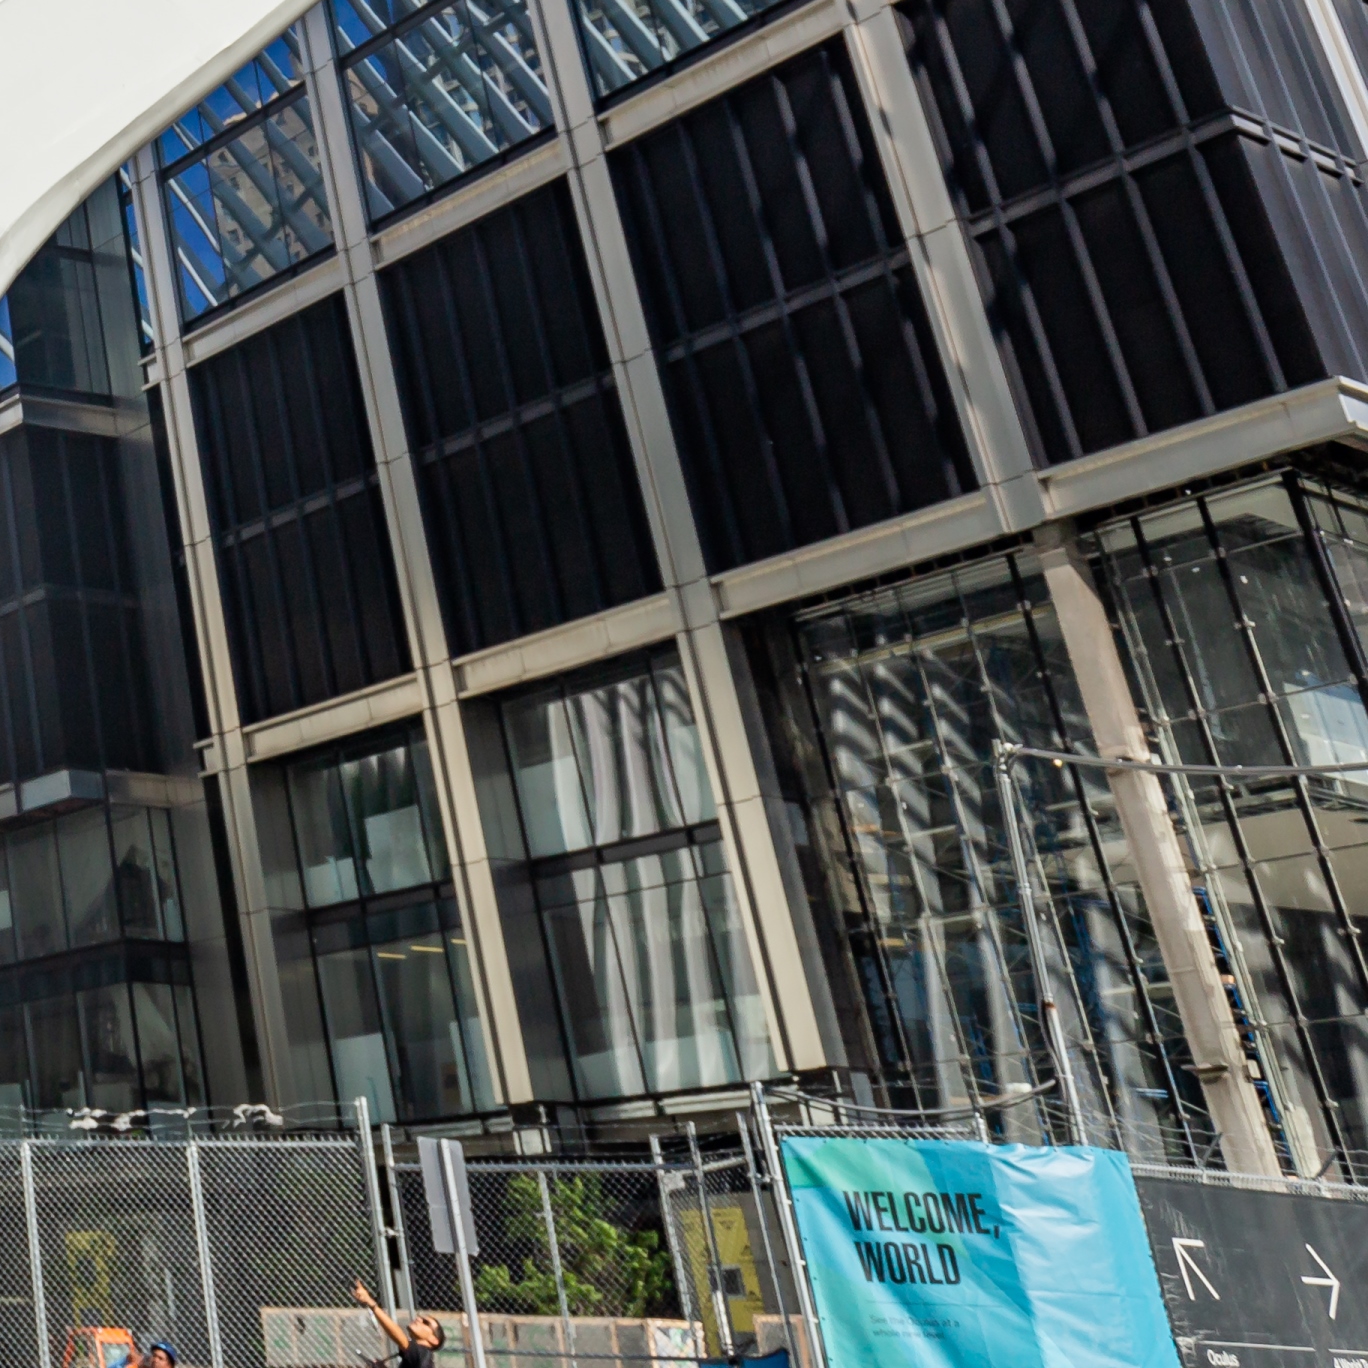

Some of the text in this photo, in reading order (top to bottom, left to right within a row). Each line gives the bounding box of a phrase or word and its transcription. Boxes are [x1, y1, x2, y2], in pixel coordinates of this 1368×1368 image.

[843, 1191, 1000, 1239] WELCOME,
[854, 1241, 961, 1285] WORLD
[1207, 1349, 1240, 1367] Oculus
